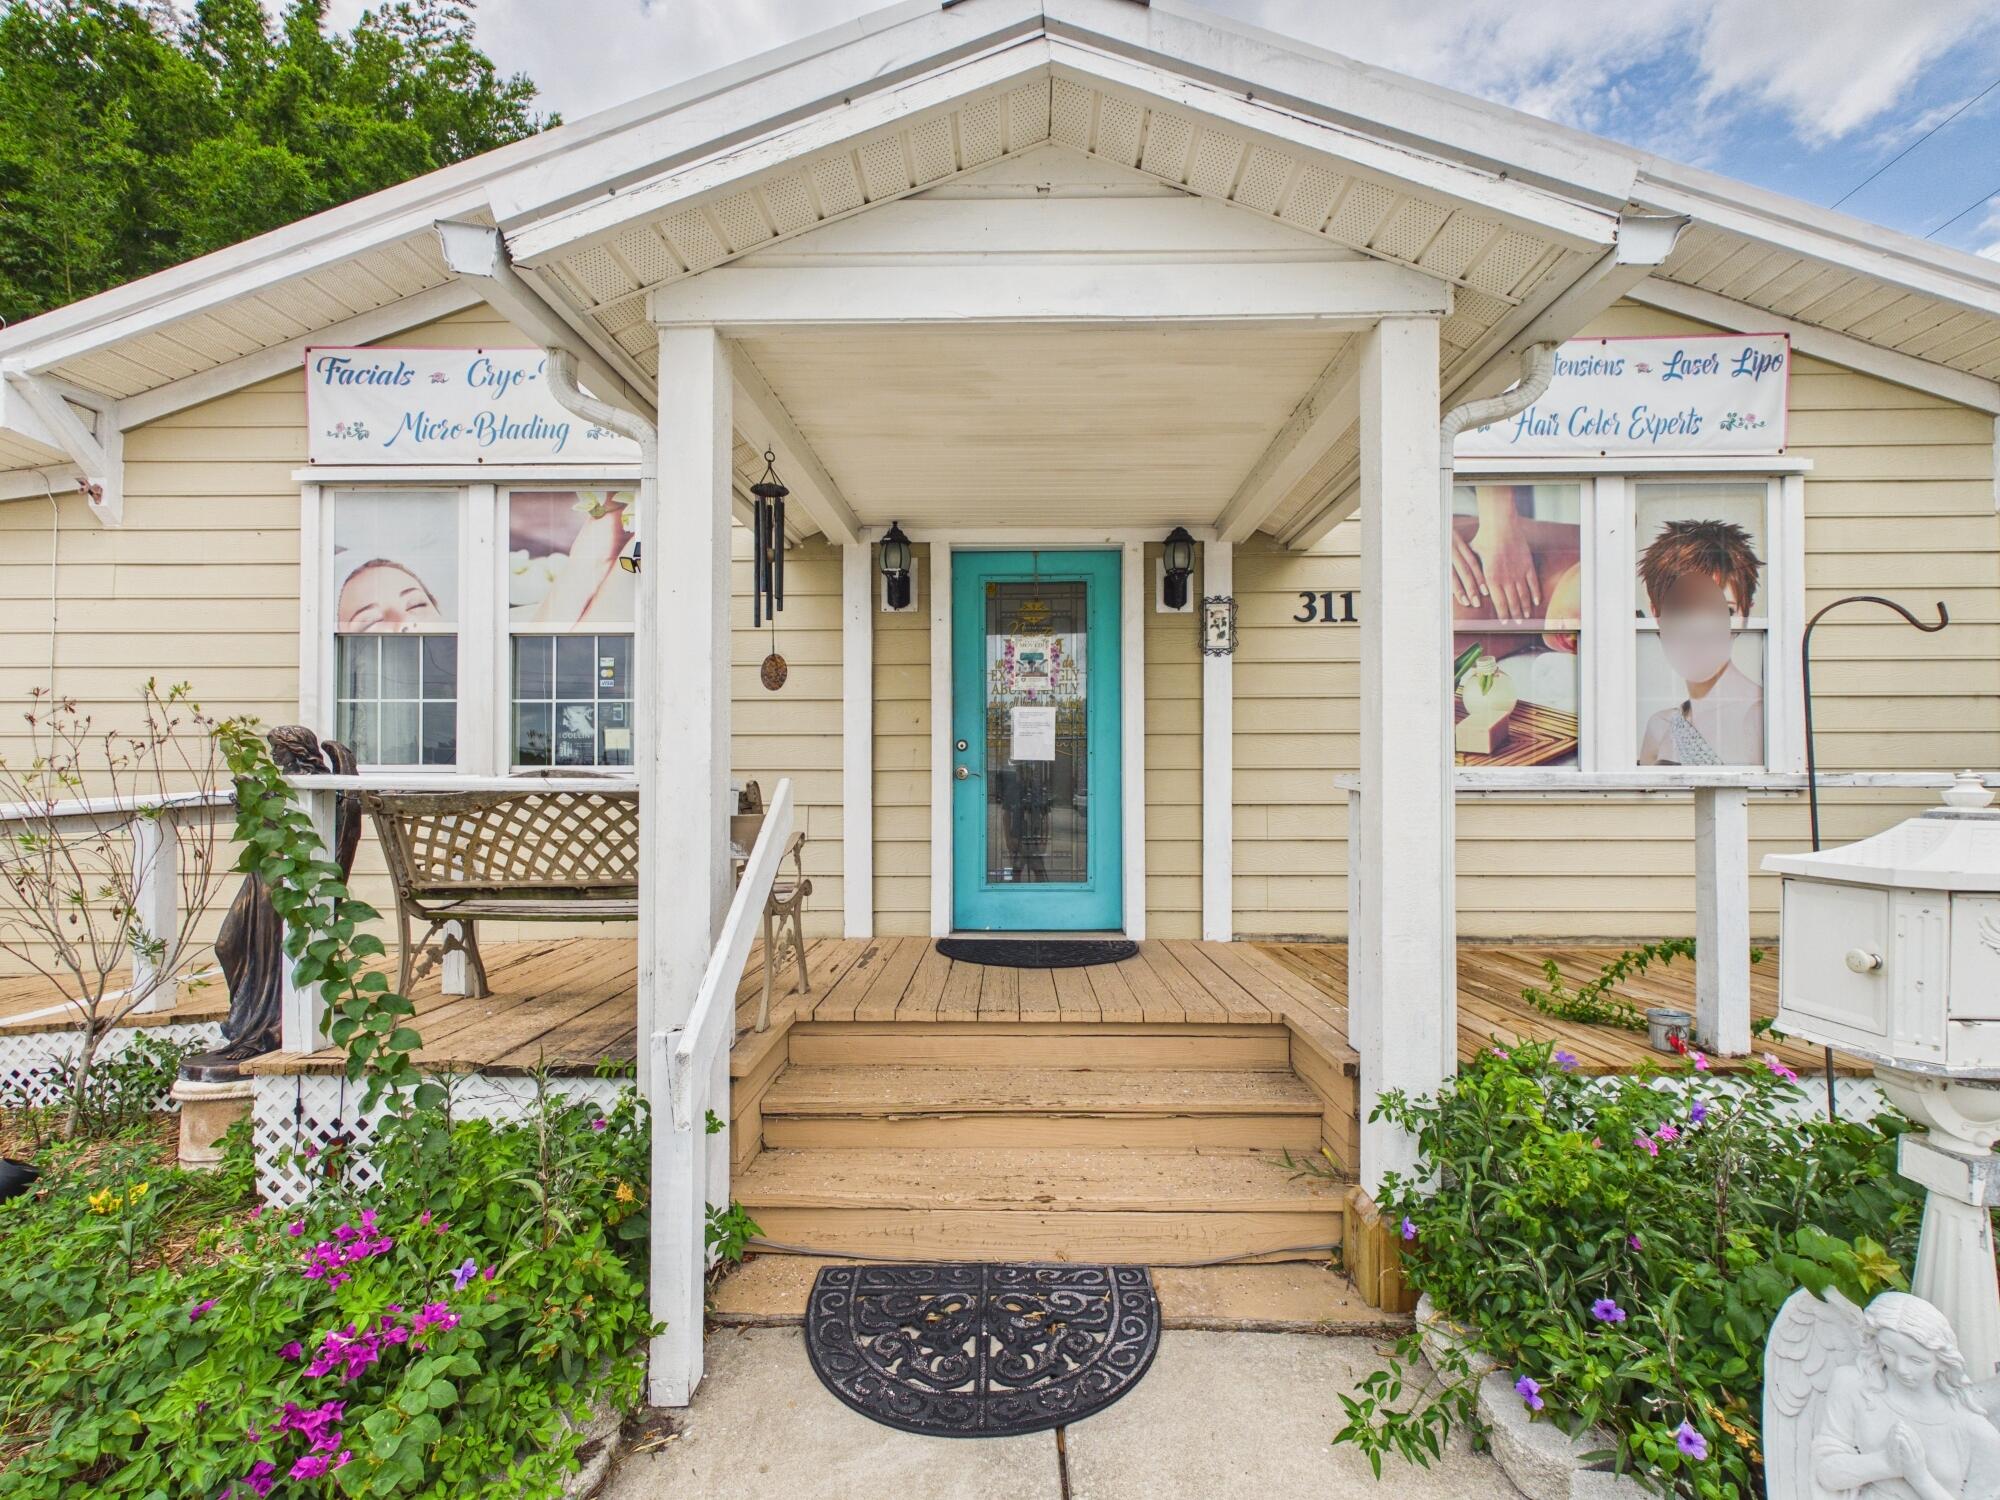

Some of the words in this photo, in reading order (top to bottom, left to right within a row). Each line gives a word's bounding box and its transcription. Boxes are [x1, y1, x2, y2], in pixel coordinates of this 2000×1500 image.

[316, 356, 416, 386] Facials
[466, 357, 546, 401] Cryo-
[1553, 351, 1625, 377] tensions
[1661, 349, 1720, 382] Laser
[1730, 346, 1784, 381] Lipo
[382, 410, 572, 454] Micro-Blading
[1509, 406, 1560, 444] Hair
[1567, 405, 1620, 438] Color
[1627, 404, 1703, 444] Experts
[1293, 590, 1359, 623] 311
